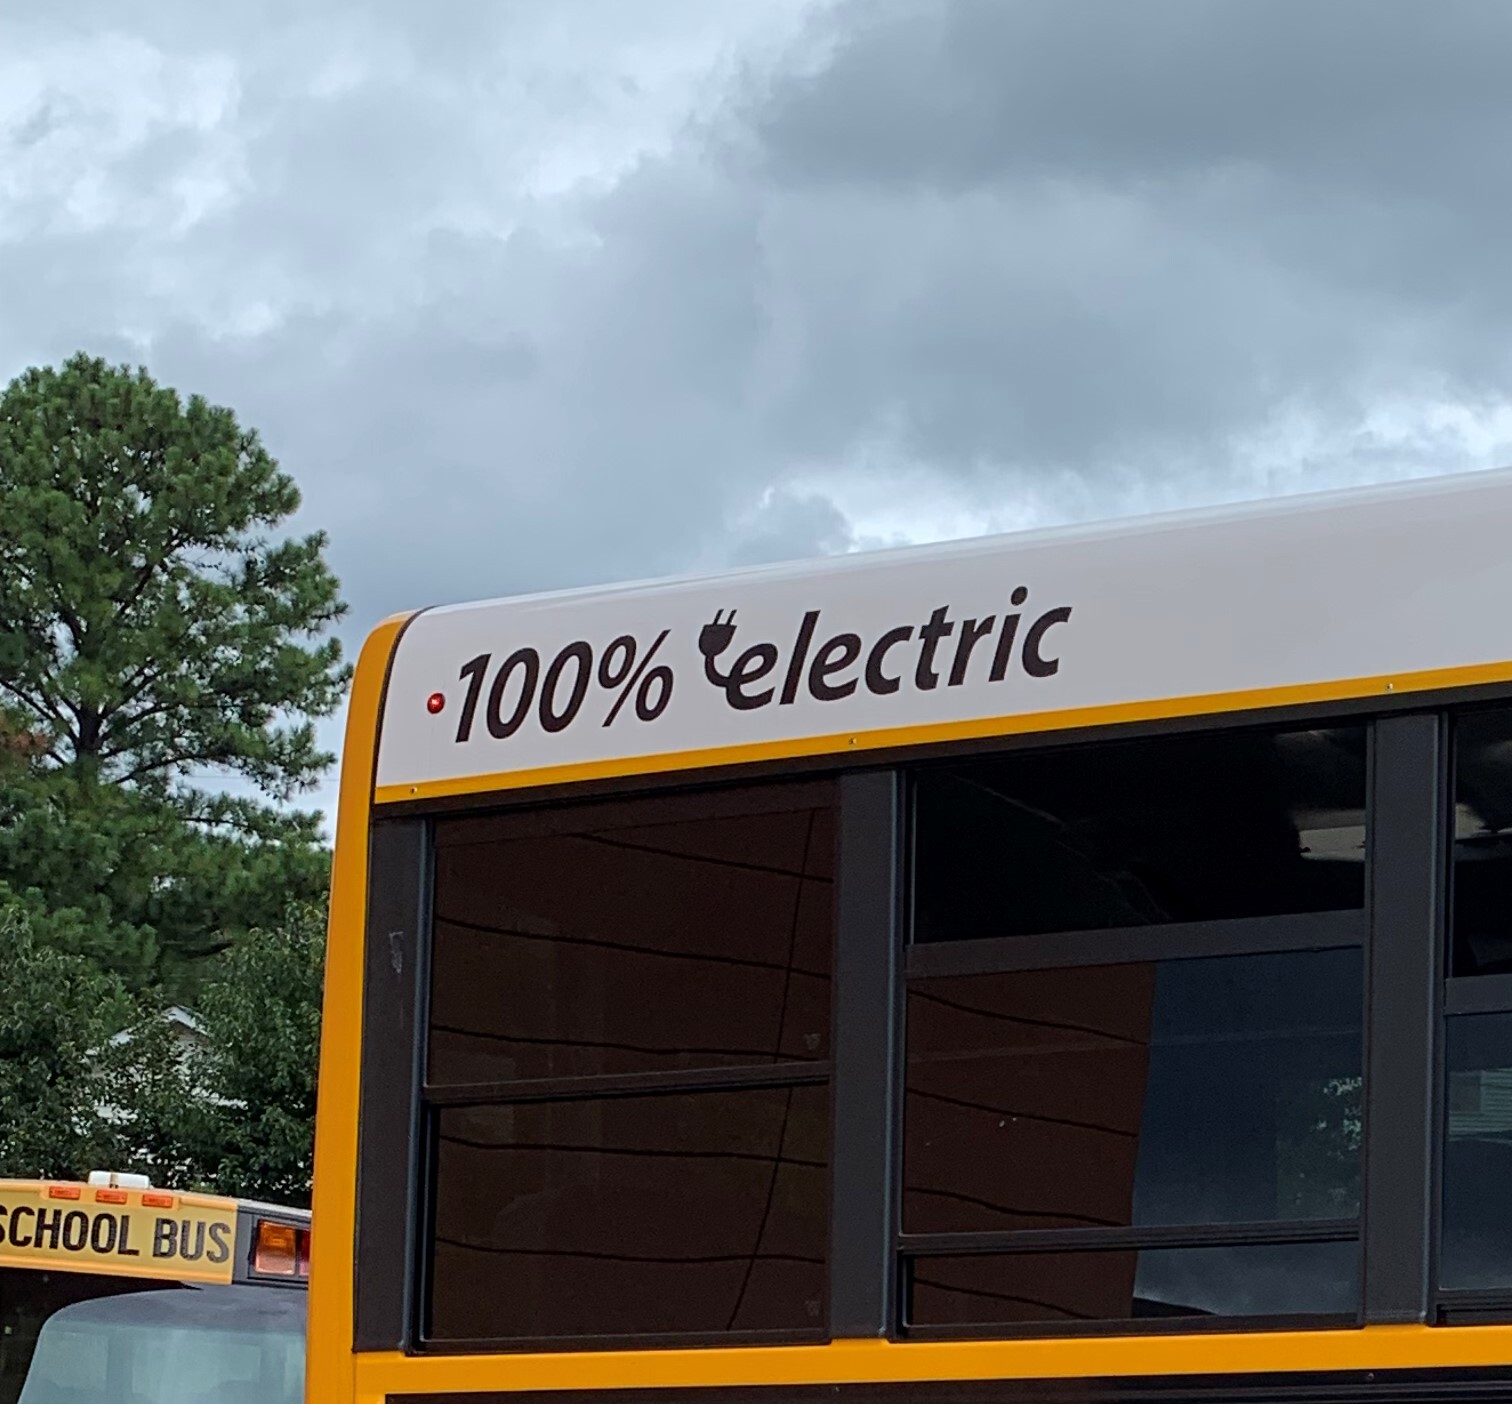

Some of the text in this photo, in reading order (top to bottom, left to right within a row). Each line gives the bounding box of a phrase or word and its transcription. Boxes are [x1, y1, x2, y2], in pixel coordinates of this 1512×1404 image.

[455, 586, 1072, 743] 100% electric
[152, 1217, 231, 1263] BUS
